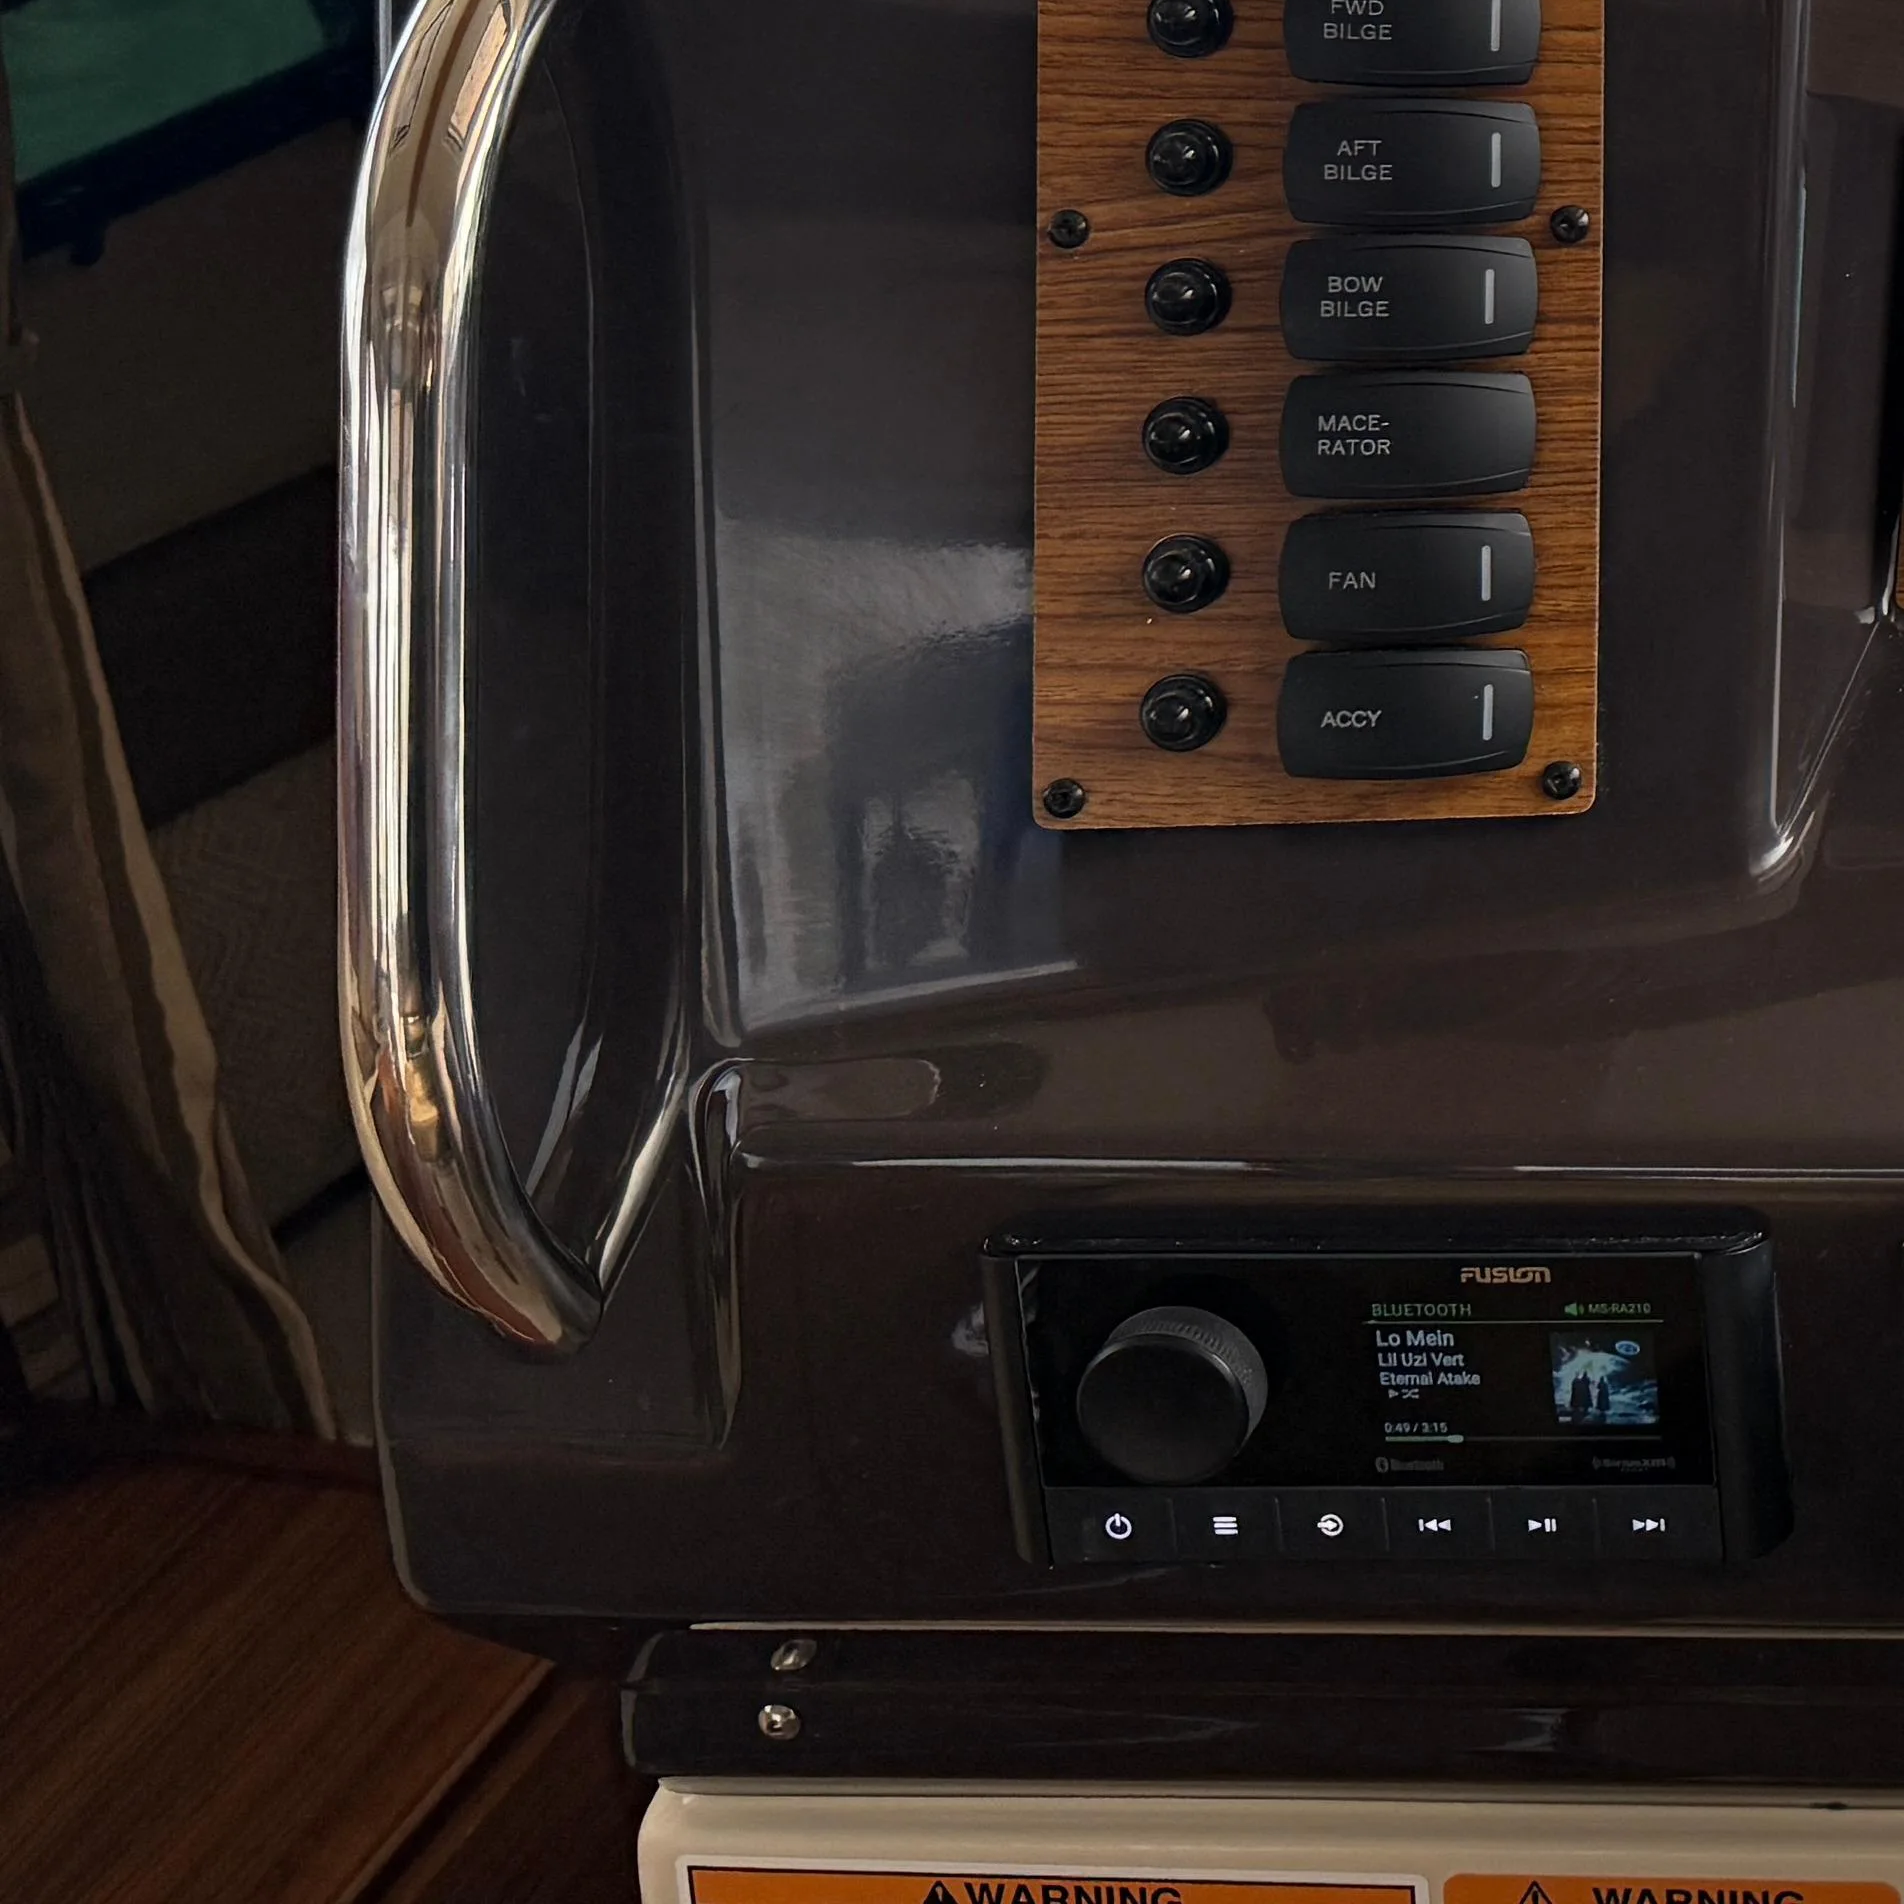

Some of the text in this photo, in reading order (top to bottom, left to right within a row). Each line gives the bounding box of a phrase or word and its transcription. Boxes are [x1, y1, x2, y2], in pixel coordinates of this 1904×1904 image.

[1323, 22, 1392, 41] BILGE
[1337, 140, 1382, 156] AFT
[1324, 164, 1393, 181] BILGE
[1328, 276, 1383, 293] BOW
[1320, 301, 1390, 318] BILGE
[1318, 414, 1390, 432] MACE-
[1317, 439, 1392, 456] RATOR
[1328, 572, 1376, 589] FAN
[1321, 710, 1382, 728] ACCY
[1460, 1266, 1551, 1284] FUSION
[1371, 1302, 1651, 1317] BLUETOOTH MS-RA210
[1376, 1329, 1455, 1347] Lo Mein
[1377, 1352, 1465, 1367] Lil Uzi Vert
[1379, 1371, 1481, 1385] Eternal Atake
[964, 1882, 1183, 1904] WARNING
